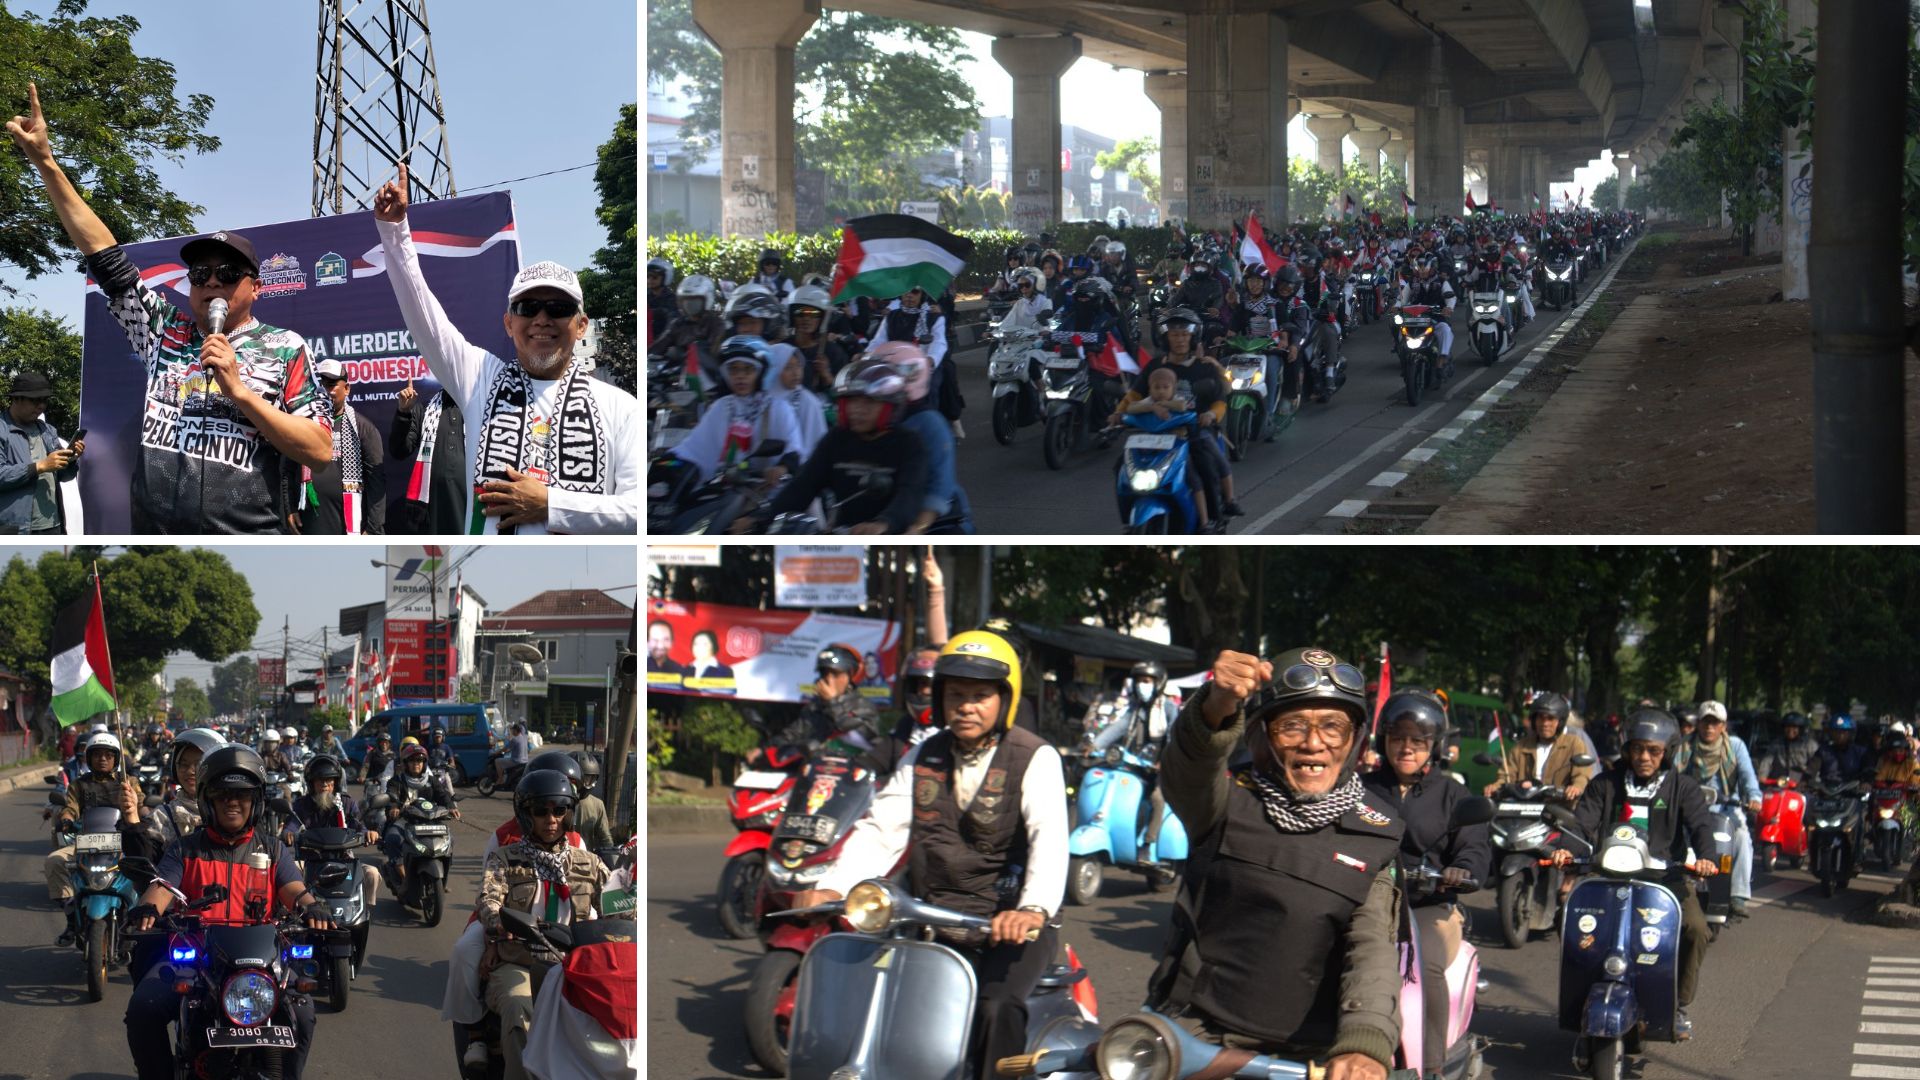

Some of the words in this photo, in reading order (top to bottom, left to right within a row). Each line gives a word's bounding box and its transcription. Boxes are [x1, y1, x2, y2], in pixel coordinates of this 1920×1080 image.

[260, 269, 302, 279] NDONESIA
[263, 289, 296, 298] BOGOR
[341, 356, 430, 383] DONESIA
[352, 394, 363, 402] AL
[158, 407, 245, 435] INDONESIA
[143, 416, 182, 450] PEACE
[183, 432, 257, 469] CONVOY
[562, 416, 594, 477] SAVE
[210, 1029, 217, 1038] F
[229, 1028, 261, 1037] 3080
[274, 1027, 290, 1037] DE
